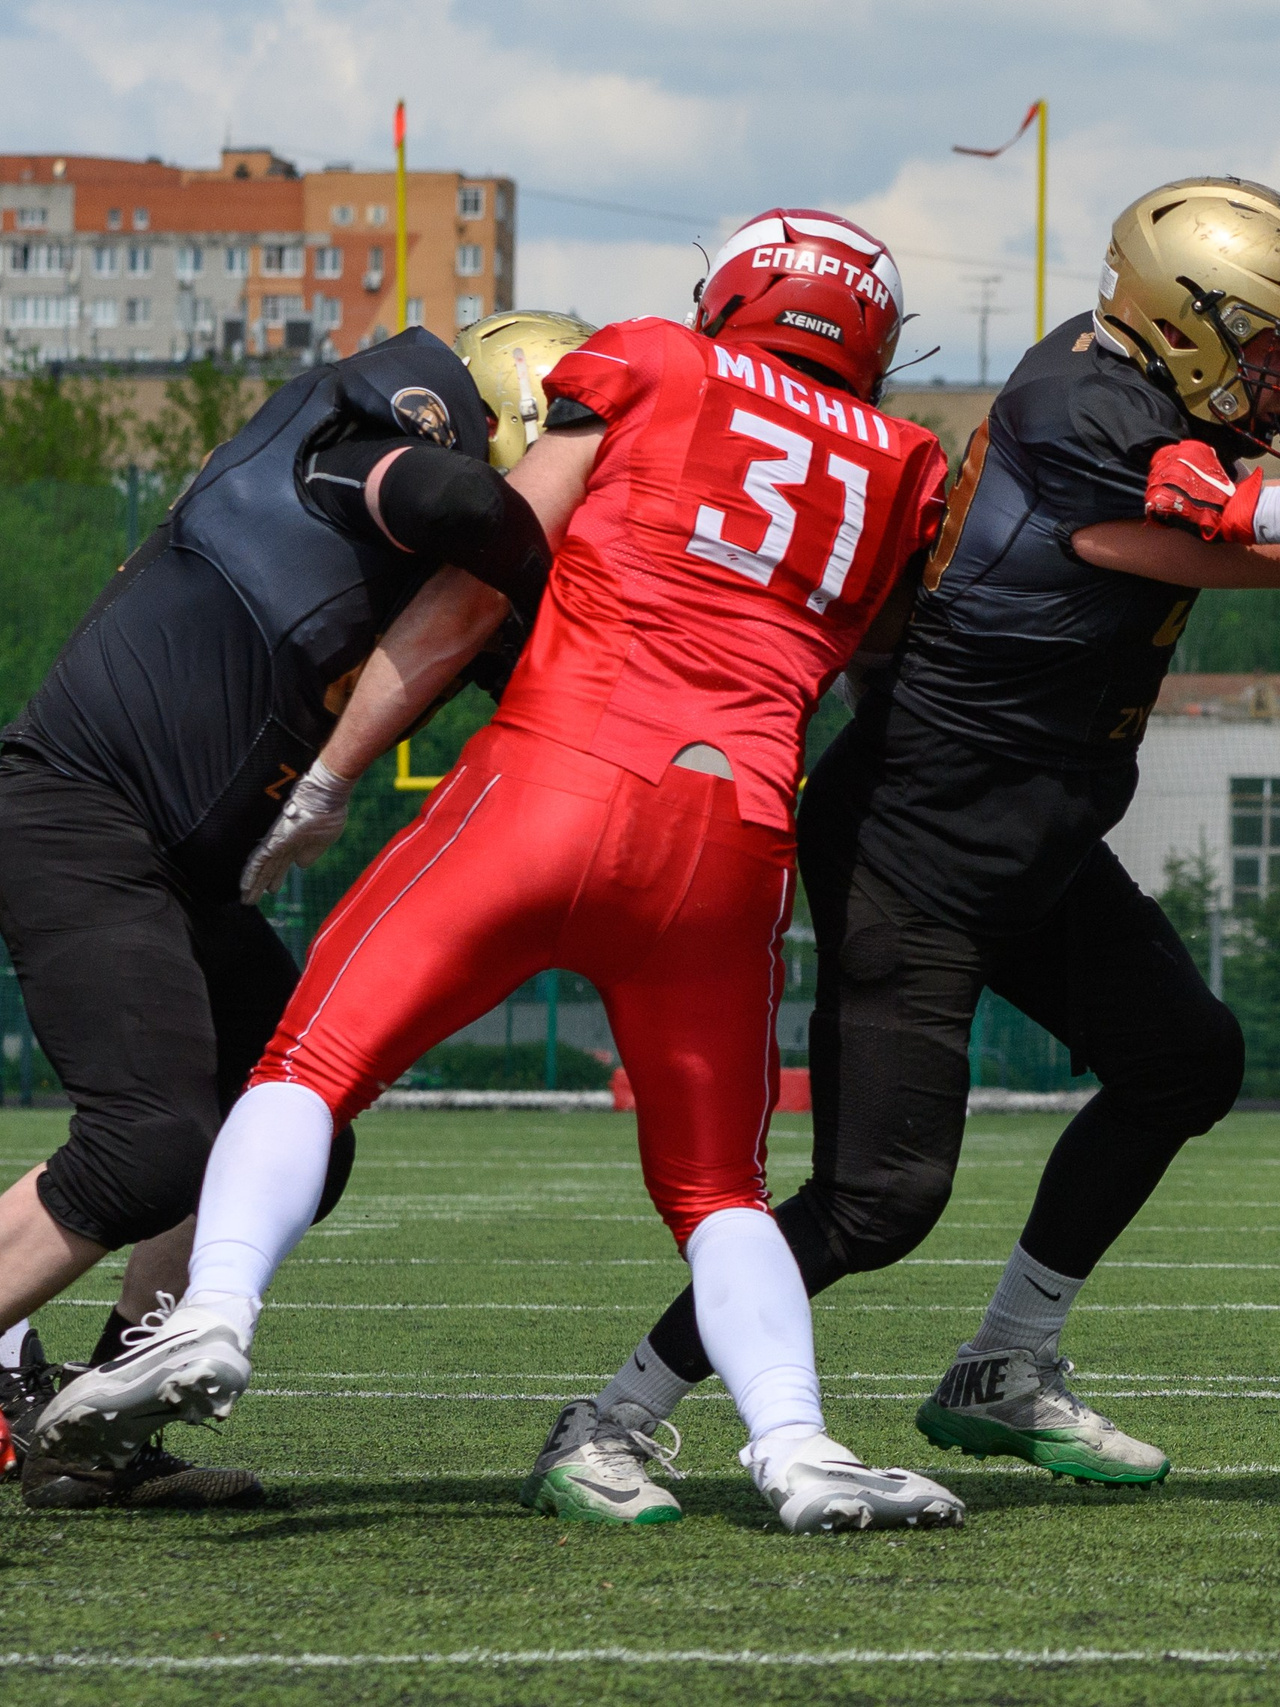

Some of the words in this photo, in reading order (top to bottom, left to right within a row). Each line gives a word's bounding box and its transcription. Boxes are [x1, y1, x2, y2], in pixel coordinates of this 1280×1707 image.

[751, 247, 889, 310] СПАРТАН
[782, 310, 842, 339] XENITH
[713, 344, 889, 449] MICHII
[685, 408, 870, 615] 31
[936, 1357, 1010, 1408] NIKE
